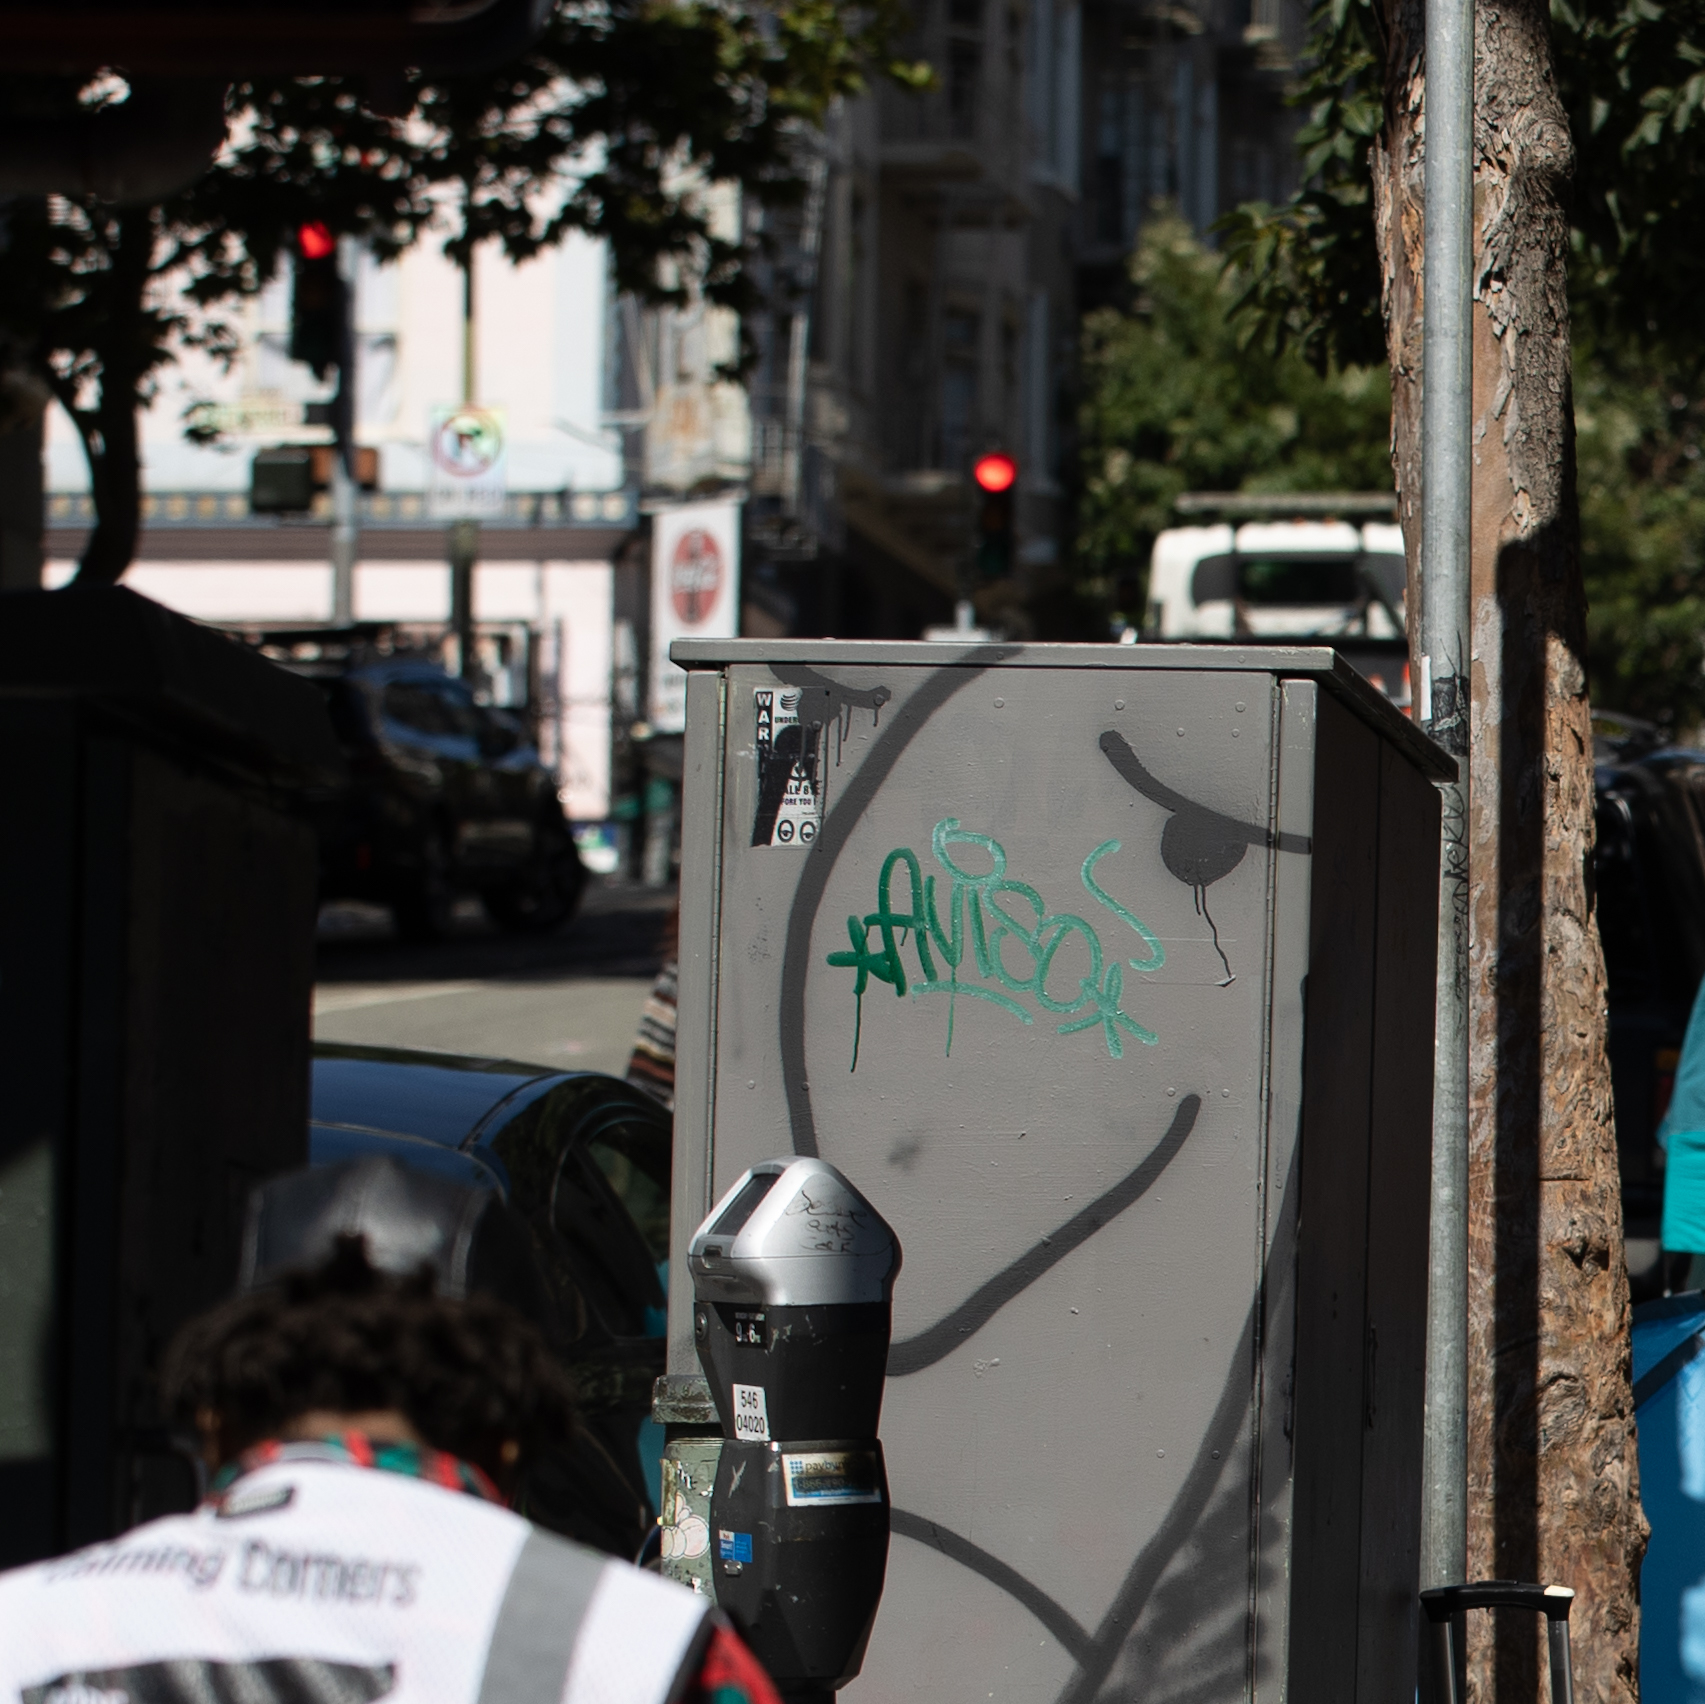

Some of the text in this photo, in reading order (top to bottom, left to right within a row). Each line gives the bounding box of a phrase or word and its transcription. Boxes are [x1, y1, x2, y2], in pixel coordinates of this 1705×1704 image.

[741, 1390, 758, 1409] 546
[736, 1414, 765, 1434] 04020
[239, 1540, 417, 1604] Corners
